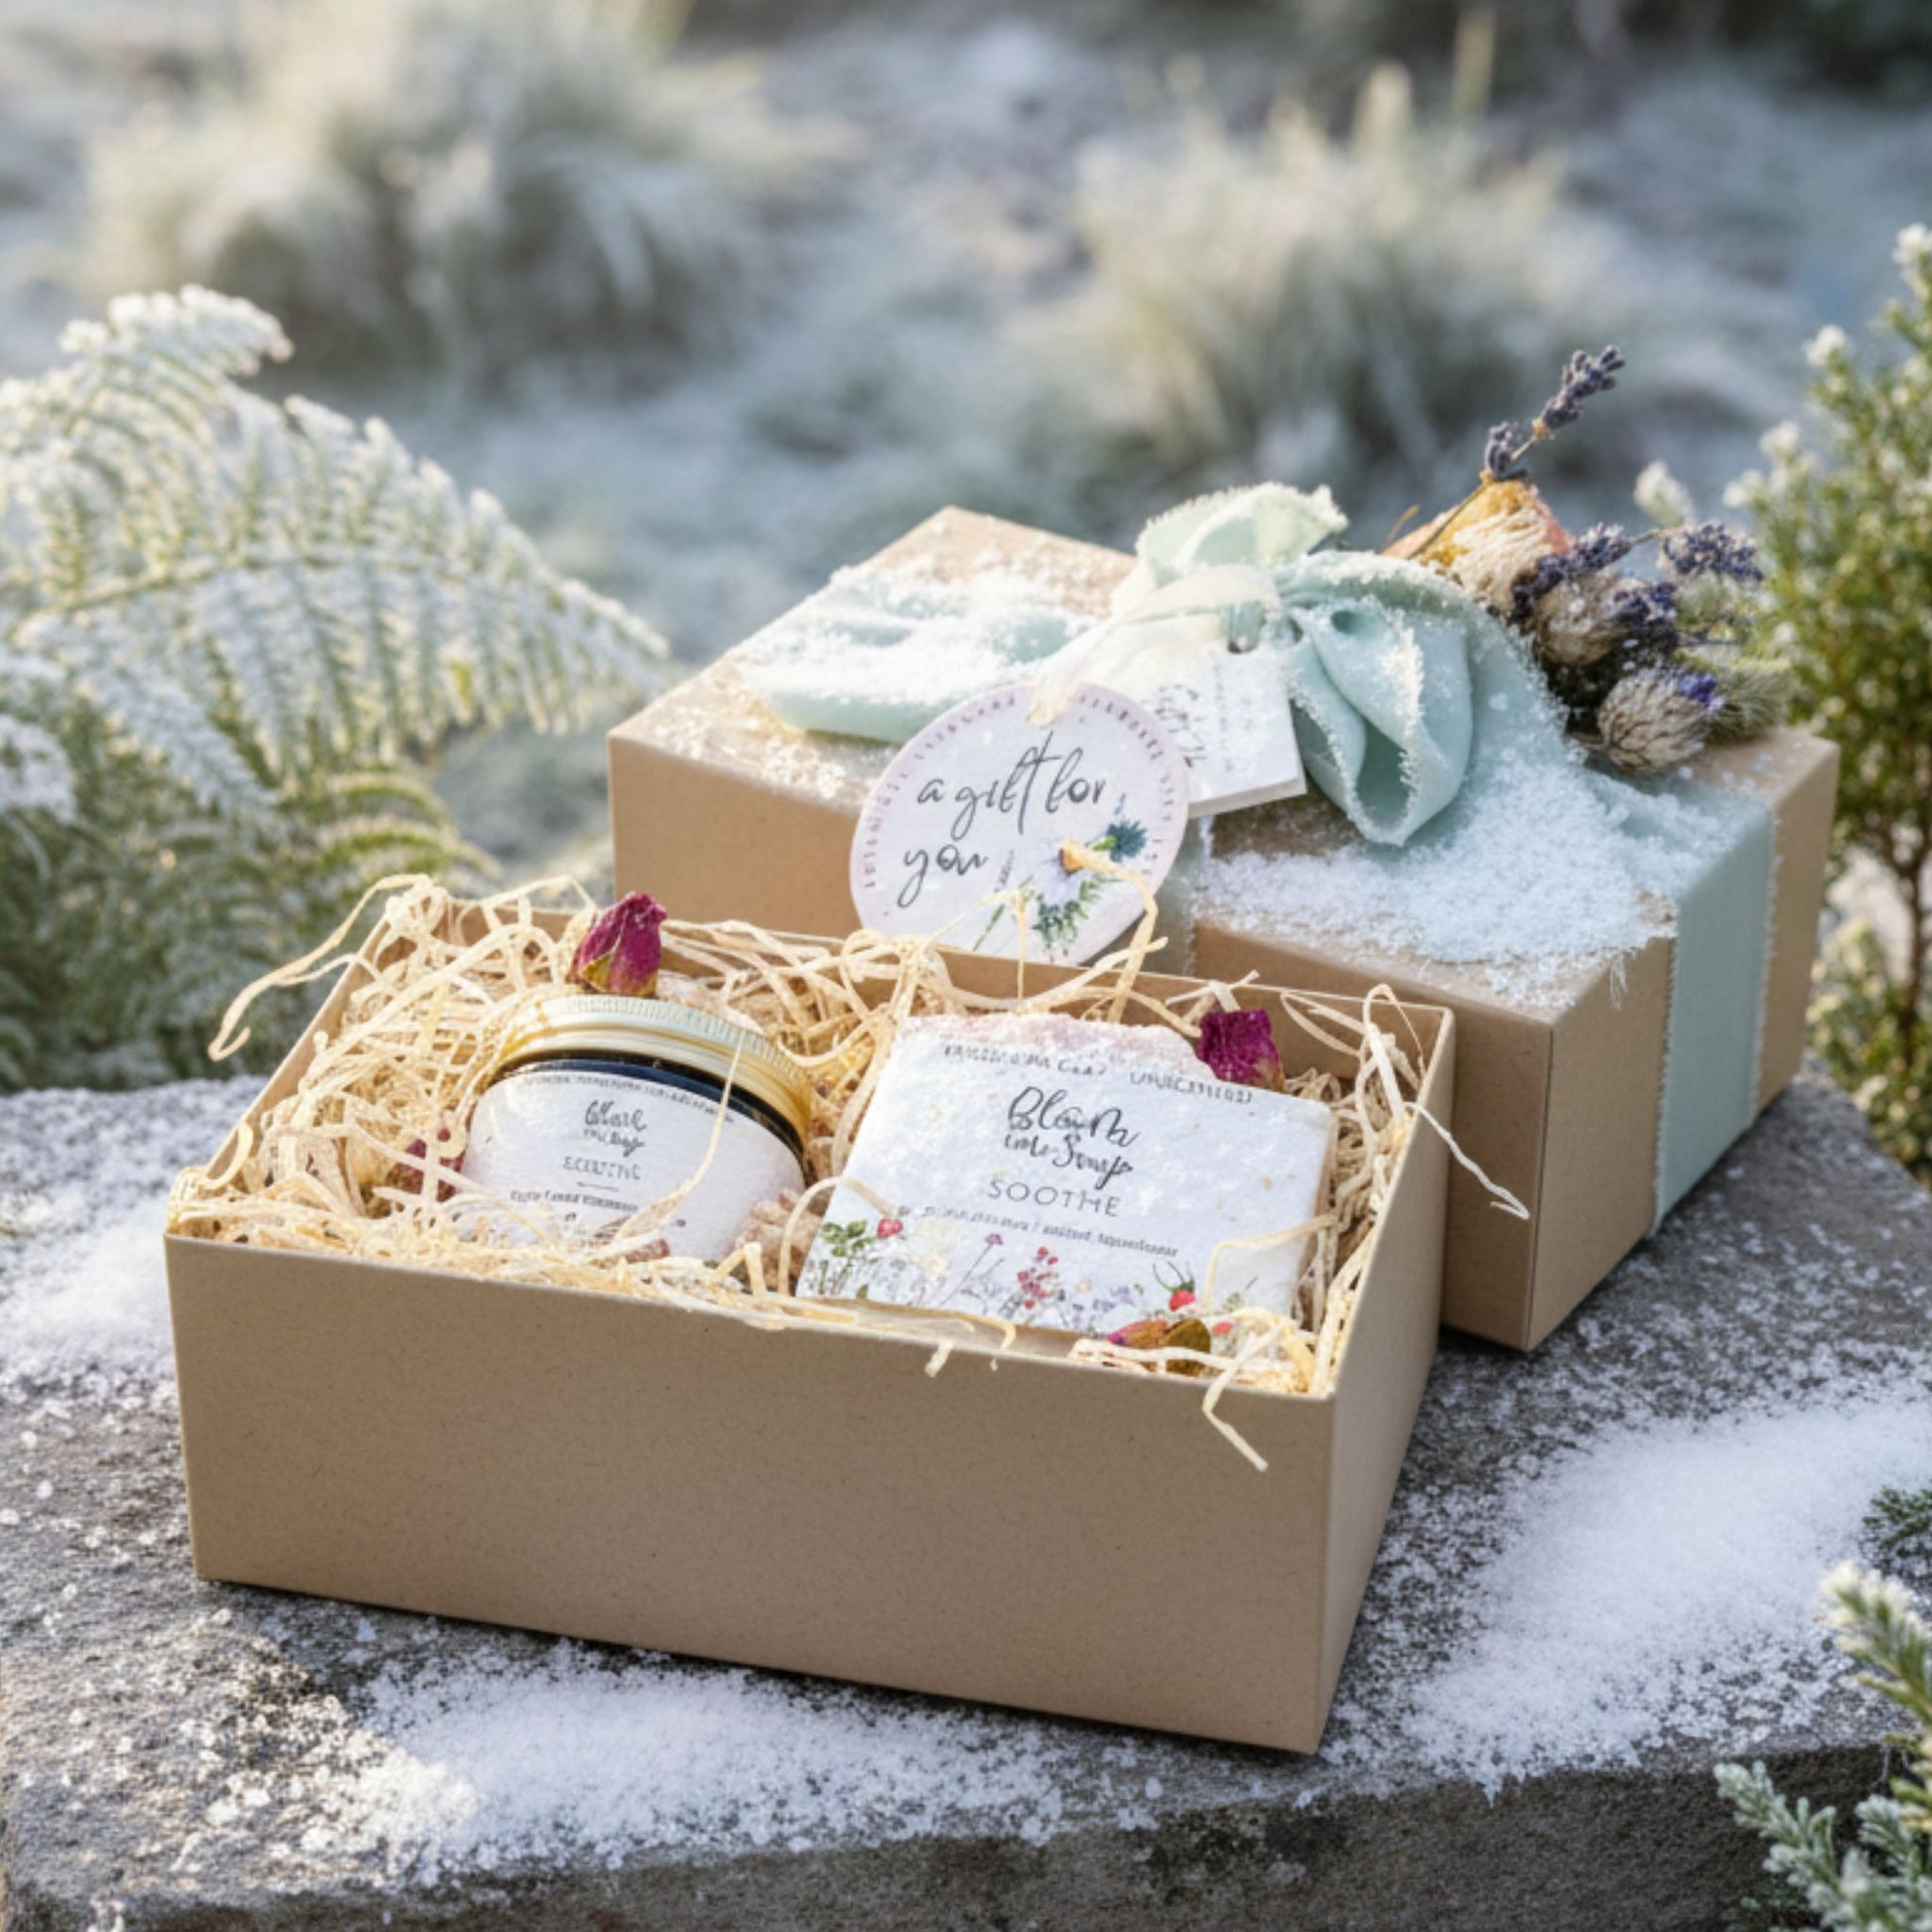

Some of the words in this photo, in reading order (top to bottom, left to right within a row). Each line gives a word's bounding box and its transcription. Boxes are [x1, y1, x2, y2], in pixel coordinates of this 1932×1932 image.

[917, 779, 944, 803] a
[950, 731, 1063, 842] gift
[1045, 747, 1107, 814] for
[897, 844, 989, 908] you
[987, 1177, 1122, 1218] SOOTHE
